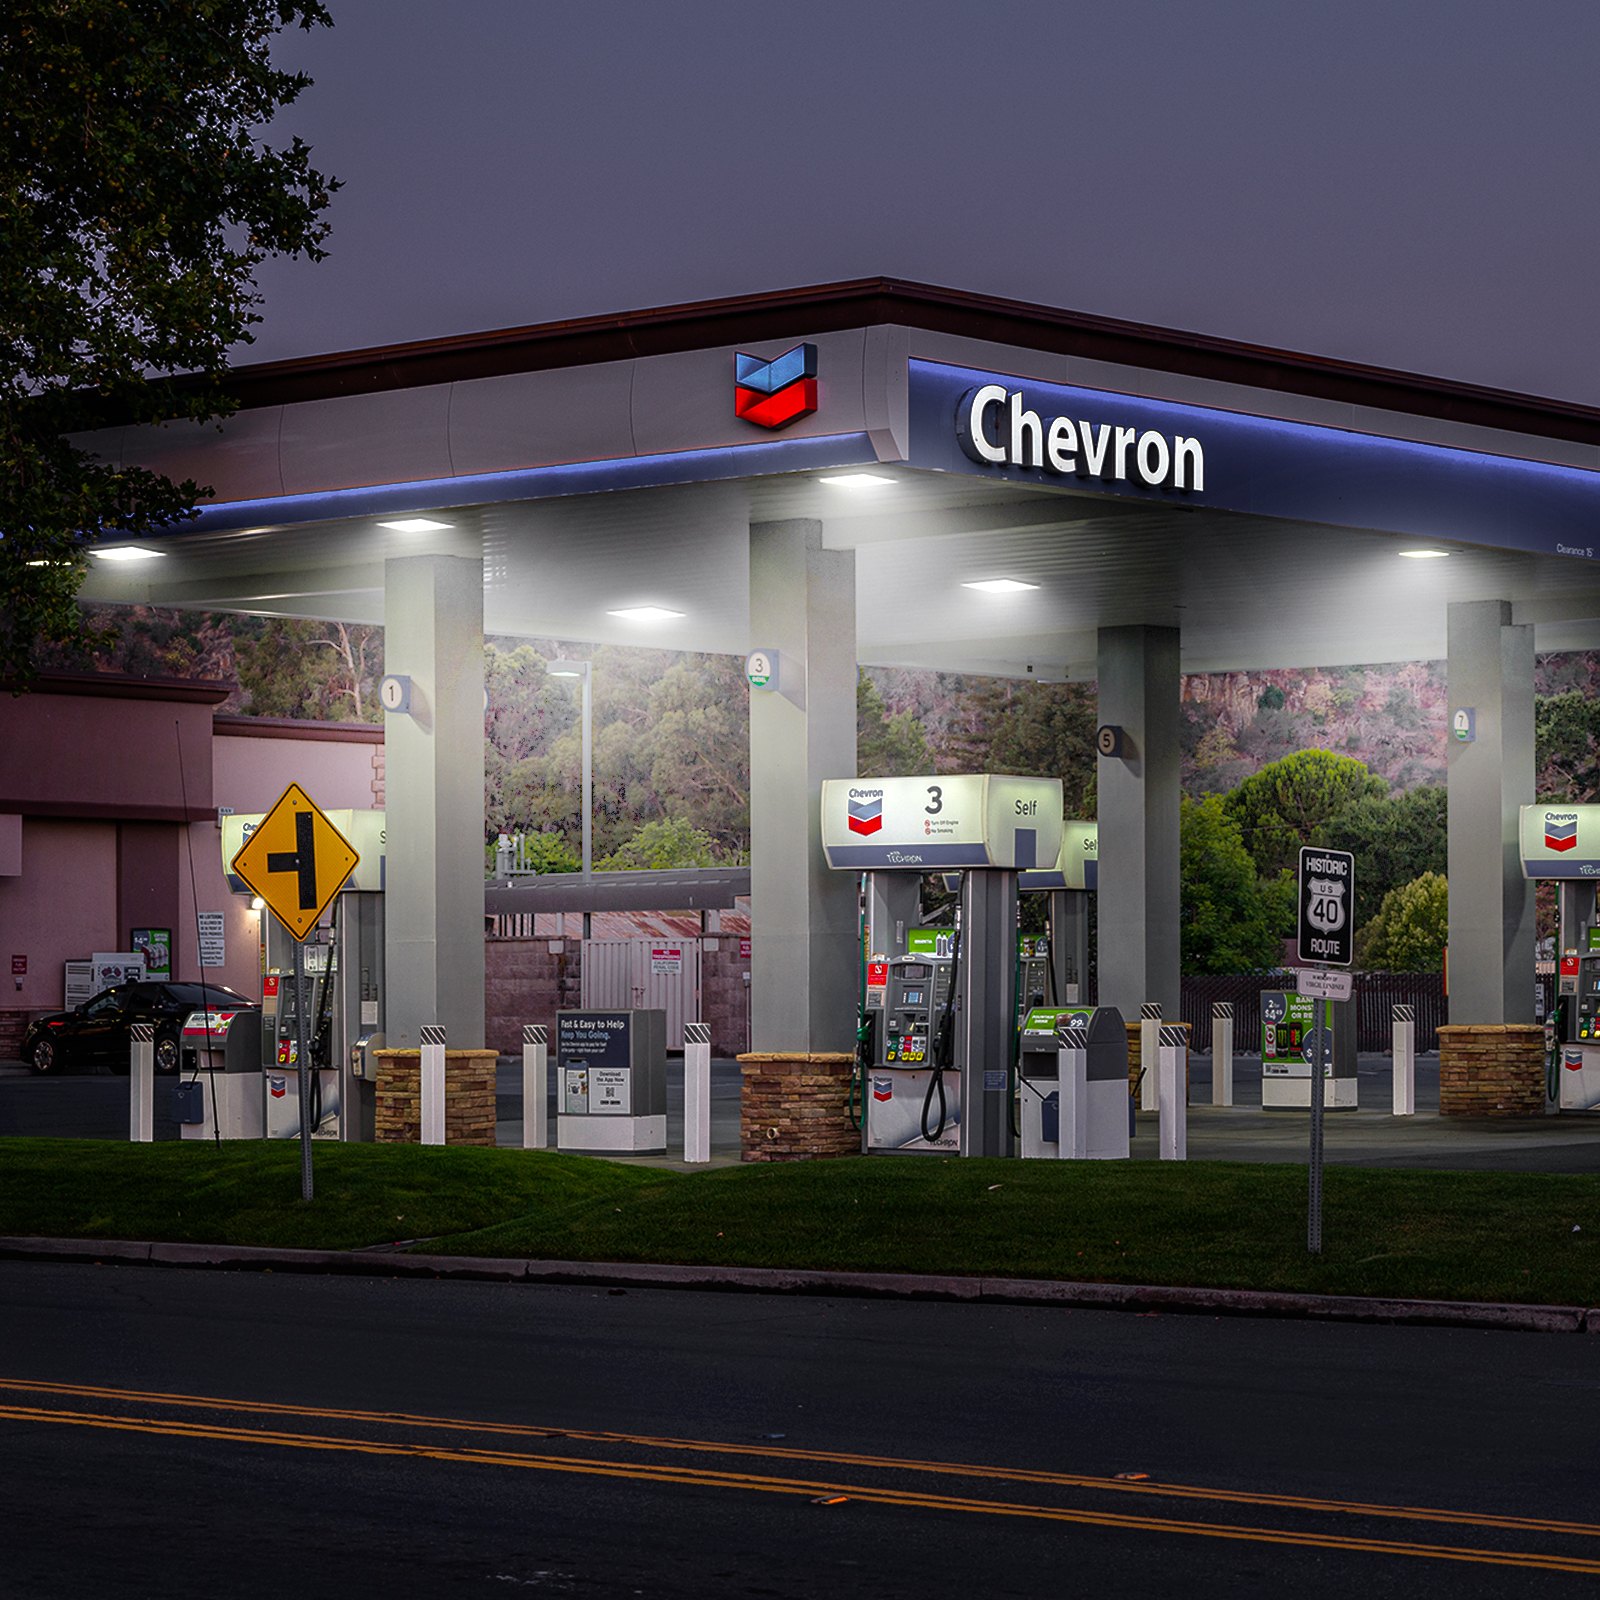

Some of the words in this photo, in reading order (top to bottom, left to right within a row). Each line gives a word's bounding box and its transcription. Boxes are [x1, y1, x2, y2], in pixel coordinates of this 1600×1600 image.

[969, 383, 1205, 492] Chevron
[755, 658, 764, 673] 3
[388, 685, 394, 702] 1
[1458, 714, 1464, 727] 7
[1103, 733, 1111, 748] 5
[848, 788, 884, 798] Chevron
[924, 785, 943, 815] 3
[1014, 799, 1037, 816] Self
[1544, 811, 1578, 821] Chevron
[1083, 838, 1097, 851] Sel
[1305, 857, 1348, 876] HISTORIC
[1313, 898, 1338, 924] 40
[1310, 938, 1340, 955] ROUTE
[1268, 999, 1274, 1008] 2
[561, 1020, 573, 1029] Fast
[579, 1020, 596, 1030] Easy
[597, 1020, 605, 1029] to
[606, 1020, 625, 1030] Help
[575, 1030, 587, 1039] You
[588, 1030, 611, 1040] Going.
